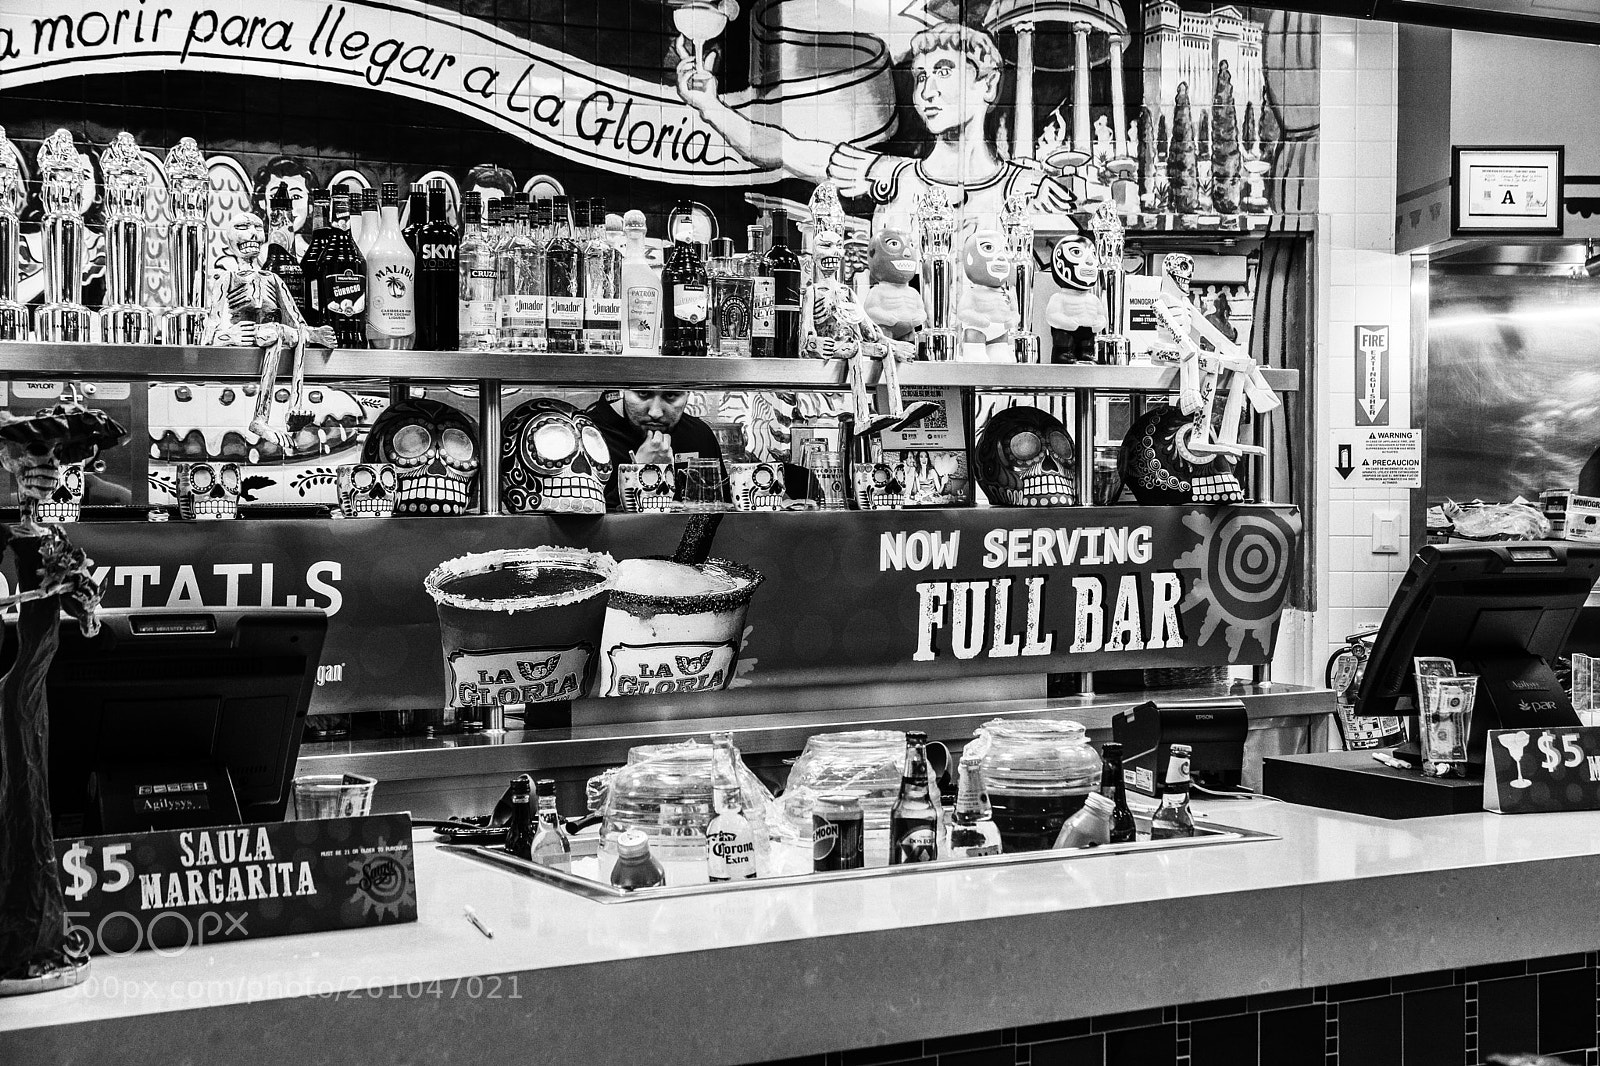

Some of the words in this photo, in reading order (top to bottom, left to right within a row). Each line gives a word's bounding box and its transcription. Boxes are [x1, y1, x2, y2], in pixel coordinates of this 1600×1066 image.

[31, 0, 172, 55] morir
[180, 8, 294, 63] para
[308, 4, 456, 86] llegar
[462, 66, 499, 98] a
[506, 63, 561, 126] La
[576, 90, 740, 165] Gloria
[1501, 190, 1515, 204] A
[422, 243, 457, 259] SKYY
[375, 264, 414, 282] MALIBU
[515, 299, 544, 313] Jimador
[552, 301, 580, 314] Jimador
[594, 302, 620, 315] Jimador
[1362, 334, 1385, 347] FIRE
[26, 382, 55, 390] TAYLOR
[879, 530, 960, 571] NOW
[982, 526, 1152, 569] SERVING
[913, 576, 1054, 661] FULL
[1069, 572, 1185, 654] BAR
[477, 669, 516, 685] LA
[638, 663, 674, 678] LA
[459, 672, 579, 706] GLORIA
[618, 668, 724, 696] GLORIA
[1537, 730, 1584, 773] $5
[816, 825, 838, 840] MOON
[179, 827, 274, 867] SAUZA
[712, 841, 755, 859] Corona
[725, 855, 749, 864] Extra
[62, 839, 135, 901] $5
[138, 861, 318, 910] MARGARITA
